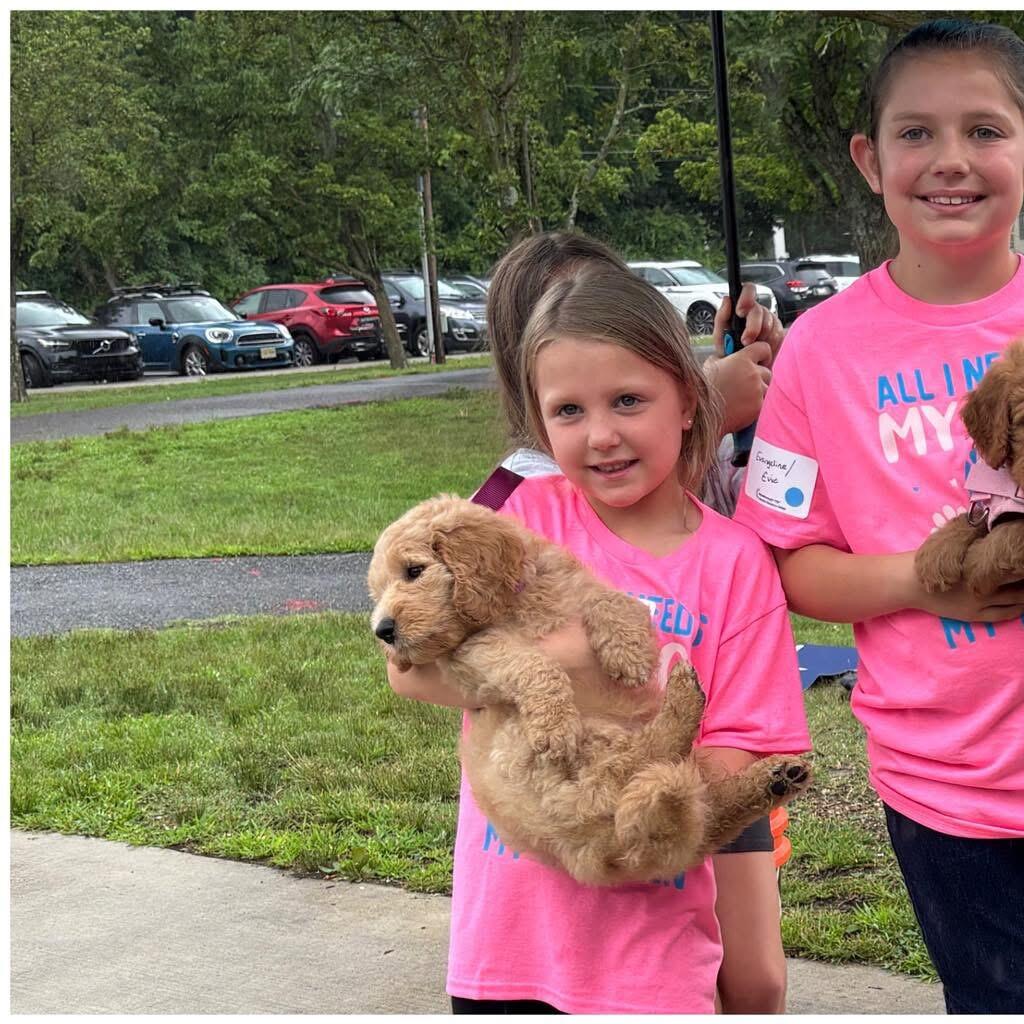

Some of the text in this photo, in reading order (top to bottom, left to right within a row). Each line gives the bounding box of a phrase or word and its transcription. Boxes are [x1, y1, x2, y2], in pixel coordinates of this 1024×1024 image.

[877, 368, 935, 409] ALL
[943, 363, 955, 396] I
[878, 401, 957, 463] MY
